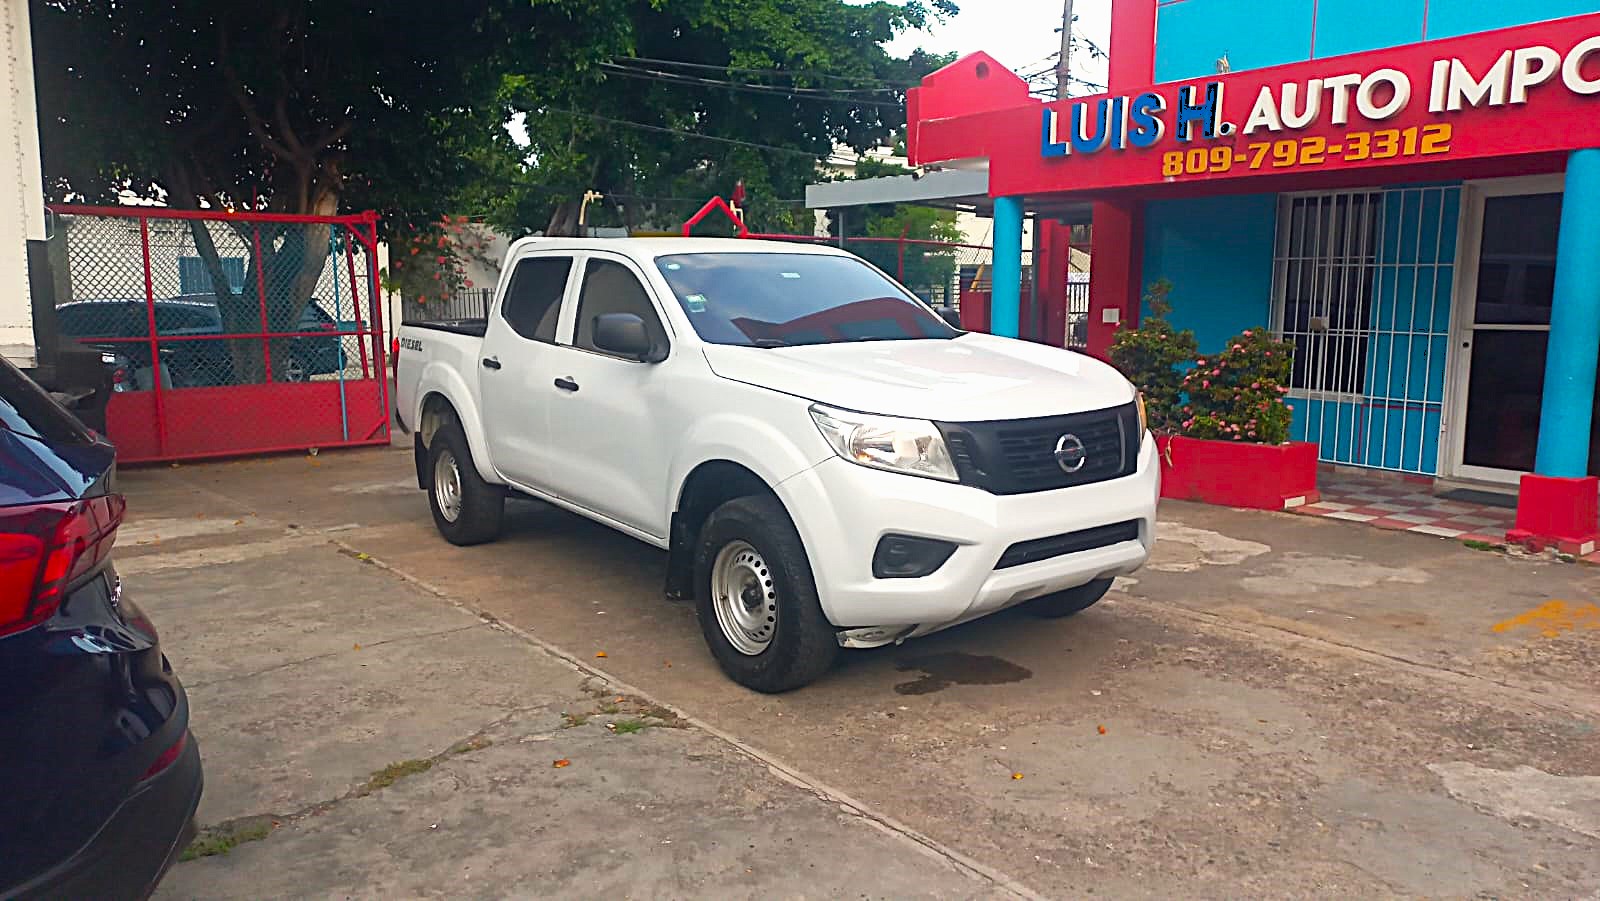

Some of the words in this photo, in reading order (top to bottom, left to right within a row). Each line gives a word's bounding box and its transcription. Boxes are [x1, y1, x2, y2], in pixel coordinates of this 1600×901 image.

[1041, 92, 1166, 158] LUIS
[1175, 81, 1237, 142] H.
[1242, 68, 1412, 134] AUTO
[1162, 123, 1453, 177] 809-792-3312
[401, 337, 423, 352] DIESEL
